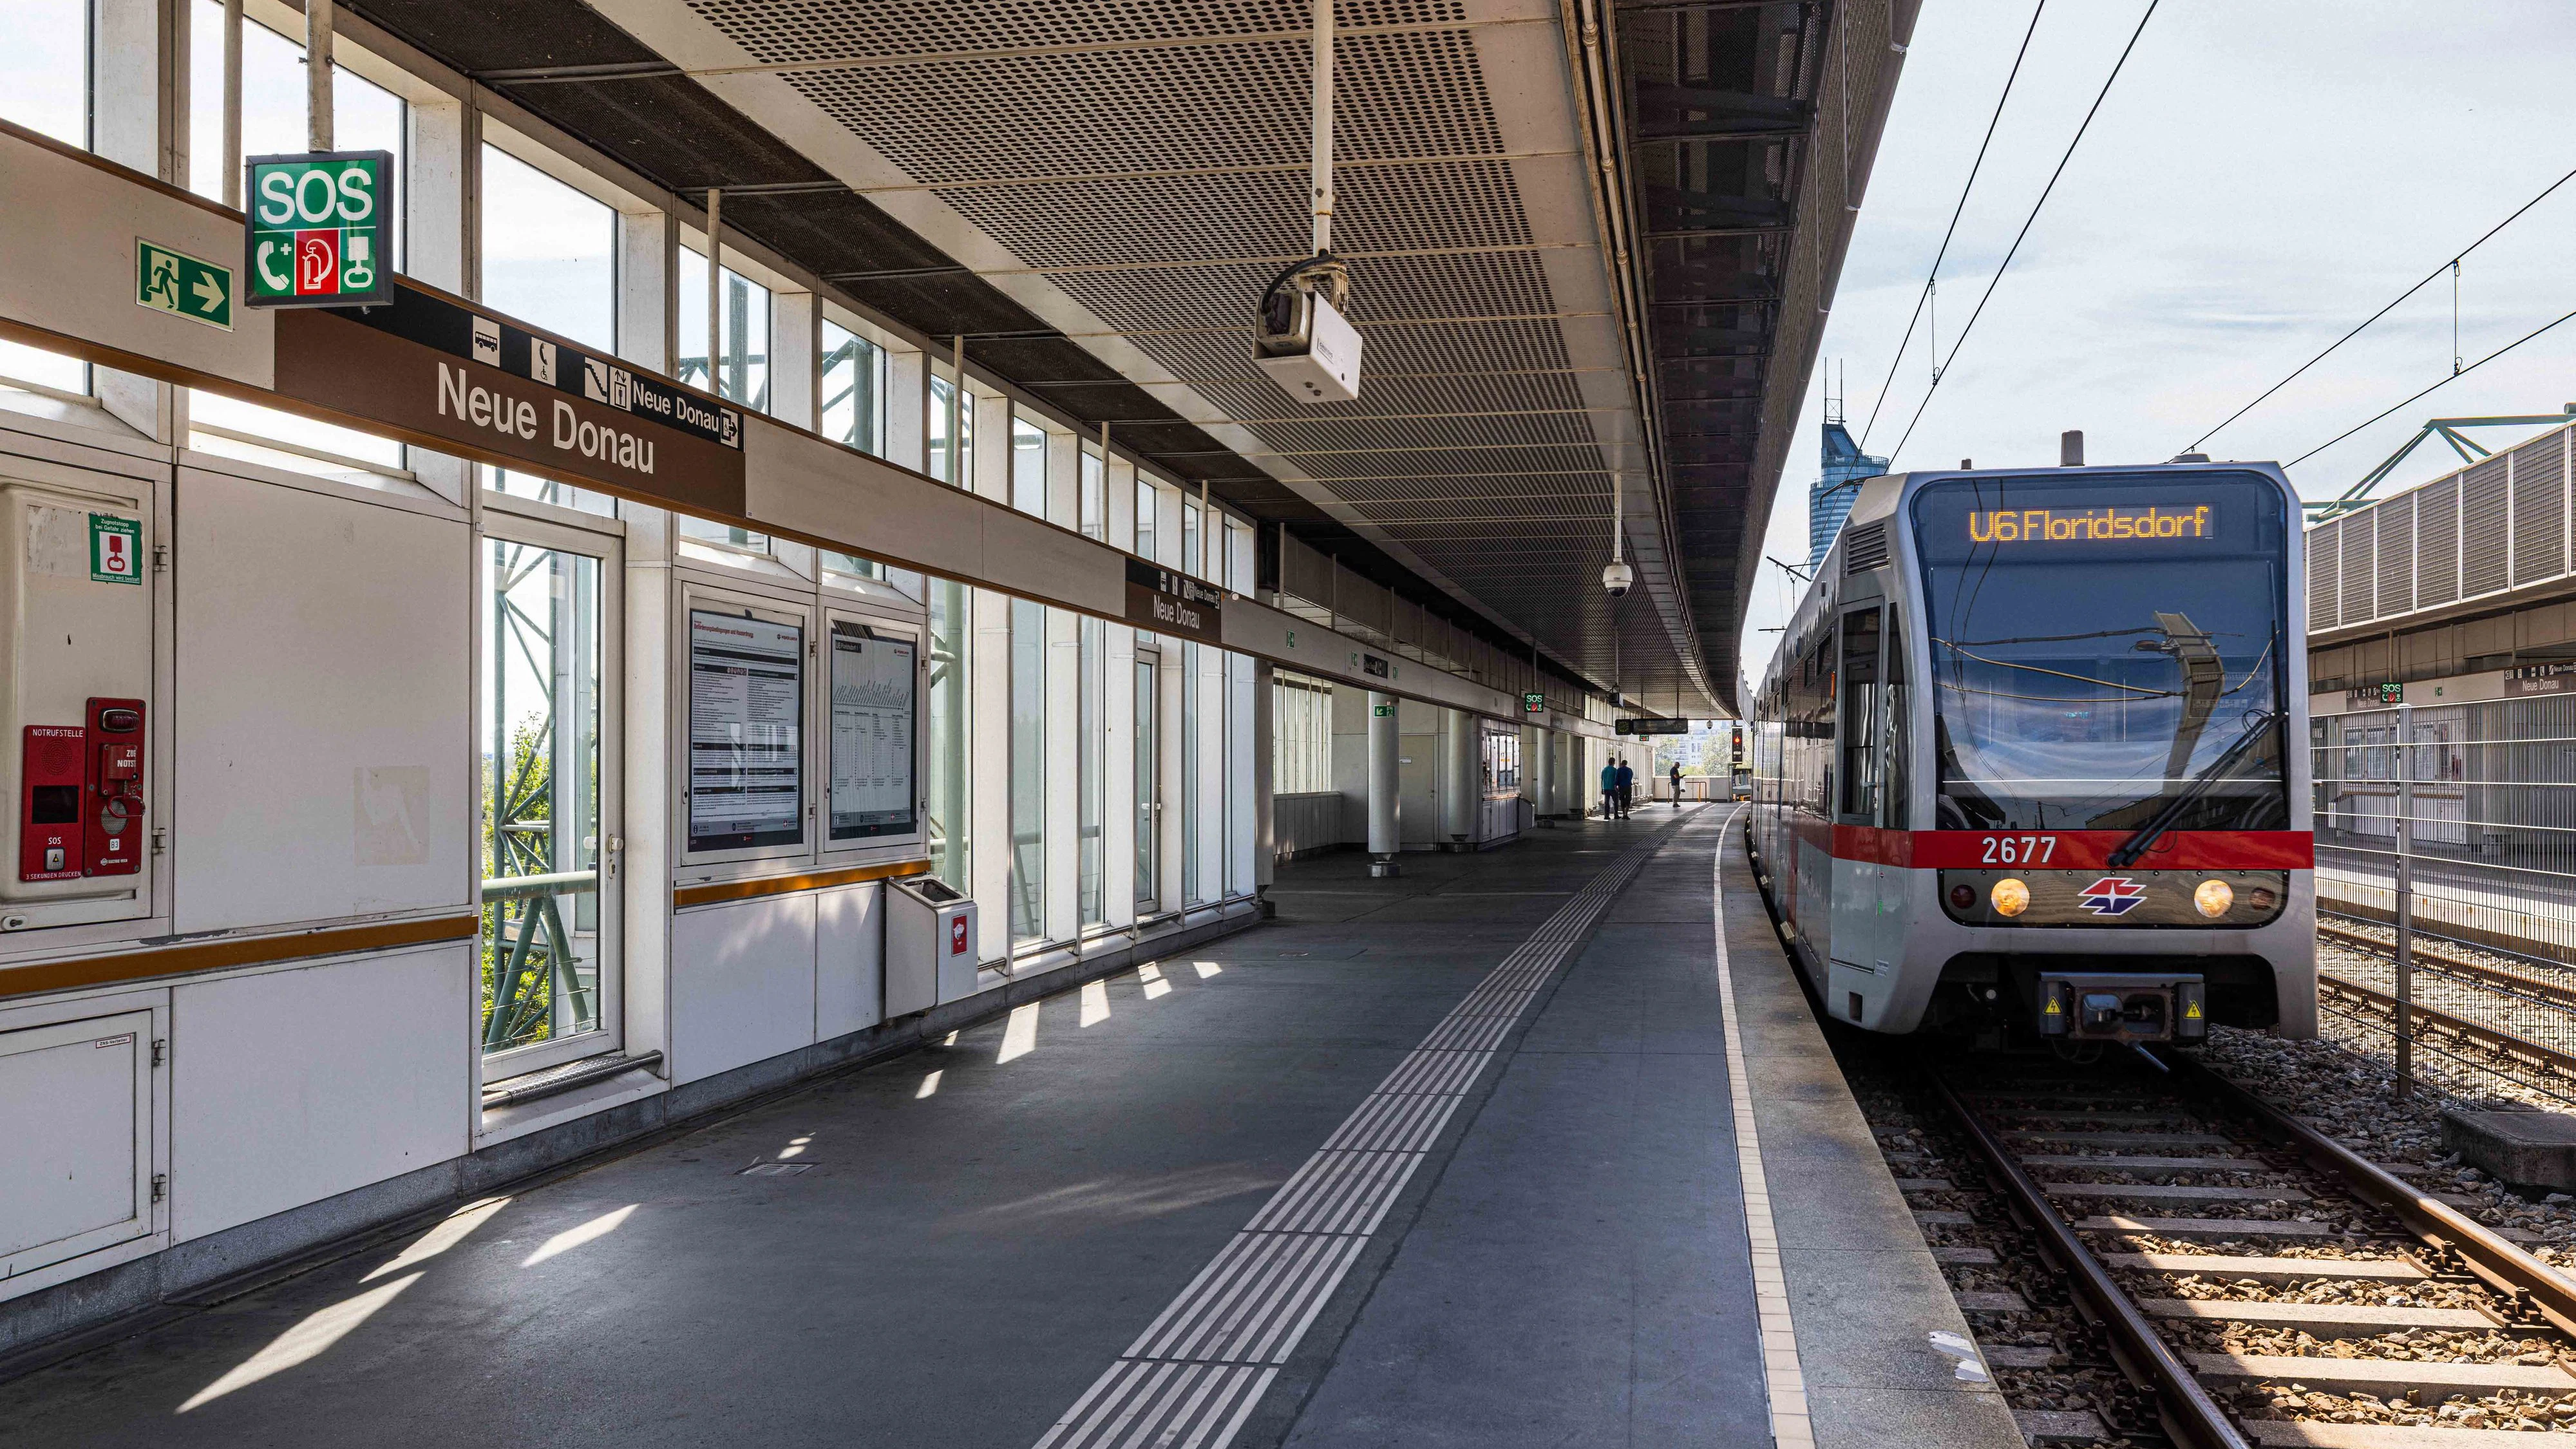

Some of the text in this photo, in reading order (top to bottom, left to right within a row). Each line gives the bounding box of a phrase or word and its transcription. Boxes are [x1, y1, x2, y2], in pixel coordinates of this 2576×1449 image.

[260, 168, 373, 224] SOS
[633, 381, 719, 432] Neue Donau
[438, 362, 654, 474] Neue Donau
[100, 518, 129, 527] Zugnotstopp
[1969, 506, 2209, 542] U6 Floridsdorf
[1194, 585, 1215, 603] Neue Donau
[1153, 594, 1200, 629] Neue Donau
[2382, 684, 2401, 692] SOS
[2522, 679, 2559, 692] Neue Donau
[2357, 697, 2380, 708] Neue Donau
[32, 729, 83, 737] NOTRUFSTELLE
[1982, 837, 2056, 863] 2677
